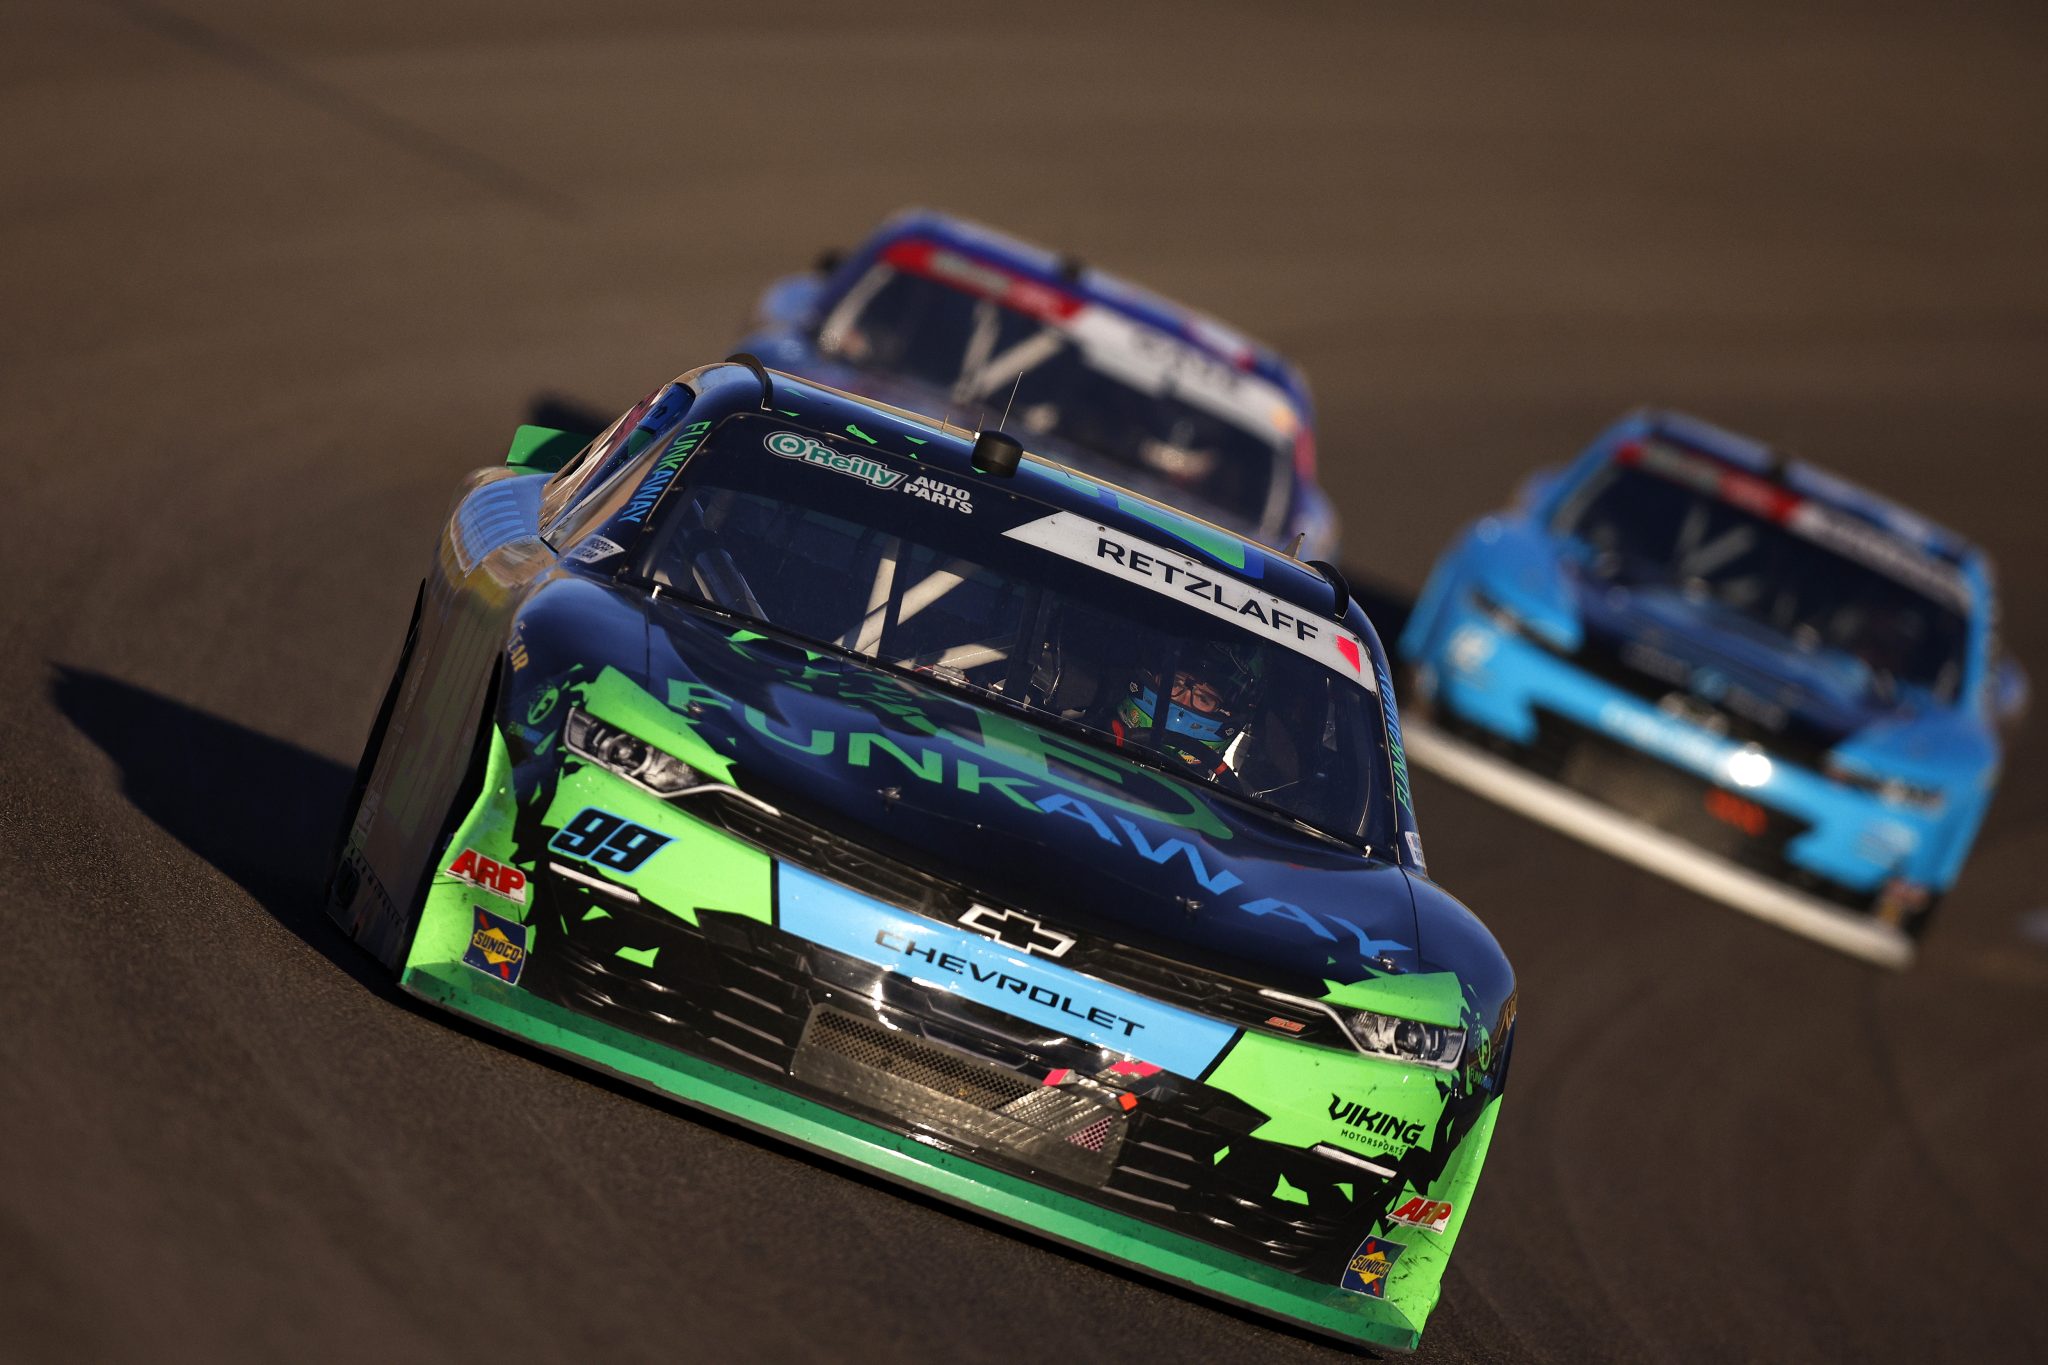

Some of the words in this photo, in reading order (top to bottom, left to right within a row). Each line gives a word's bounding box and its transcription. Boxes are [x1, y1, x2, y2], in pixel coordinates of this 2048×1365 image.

[617, 420, 712, 524] FUNKAWAY
[767, 432, 901, 488] O'Reilly
[902, 483, 974, 514] PARTS
[912, 475, 971, 501] AUTO
[1096, 537, 1319, 642] RETZLAFF
[548, 806, 679, 875] 99
[667, 677, 1414, 958] FUNKAWAY
[447, 848, 527, 897] ARP
[474, 931, 522, 962] SUNOCO
[874, 928, 1146, 1037] CHEVROLET
[1328, 1092, 1426, 1147] VIKING
[1340, 1128, 1404, 1156] MOTORSPORTS
[1351, 1255, 1392, 1277] SUNOCO
